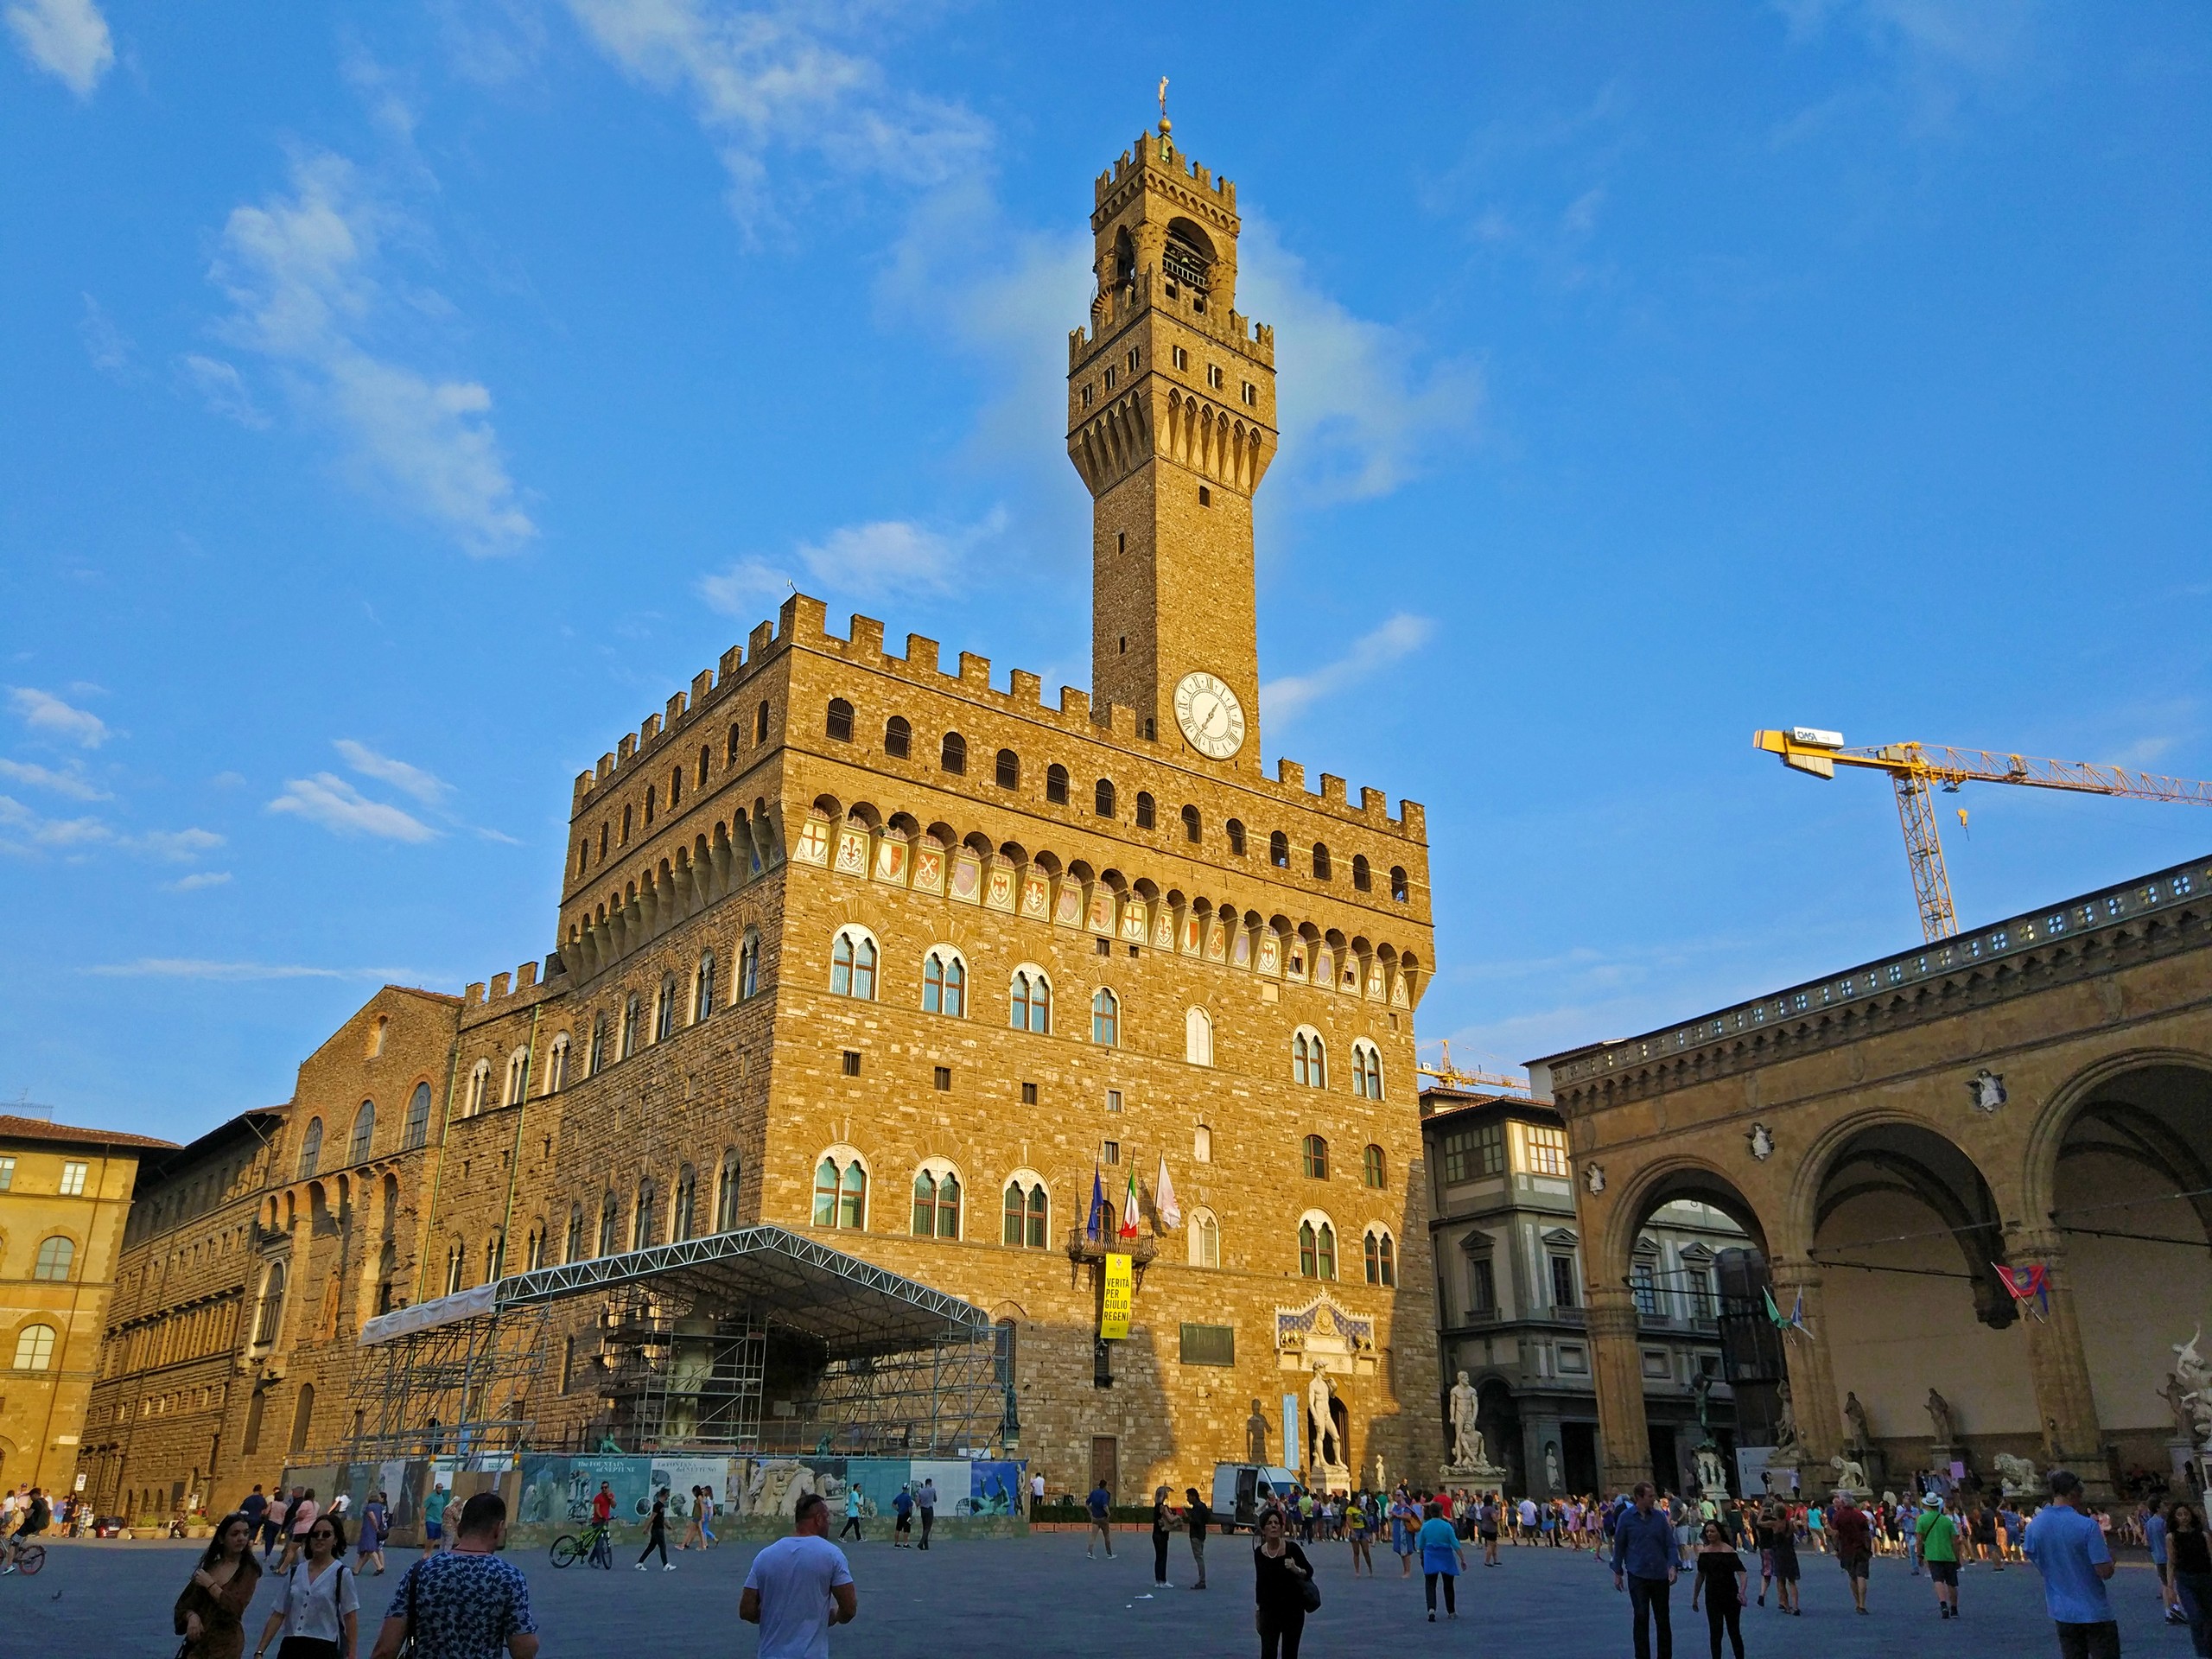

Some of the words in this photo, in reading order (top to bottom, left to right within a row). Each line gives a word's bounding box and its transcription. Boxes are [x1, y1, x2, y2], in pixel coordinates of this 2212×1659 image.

[1205, 676, 1214, 690] XII
[1107, 1277, 1129, 1287] VERITÀ
[1106, 1289, 1119, 1299] PER
[1105, 1300, 1128, 1309] GIULIO
[1103, 1312, 1128, 1321] REGENI
